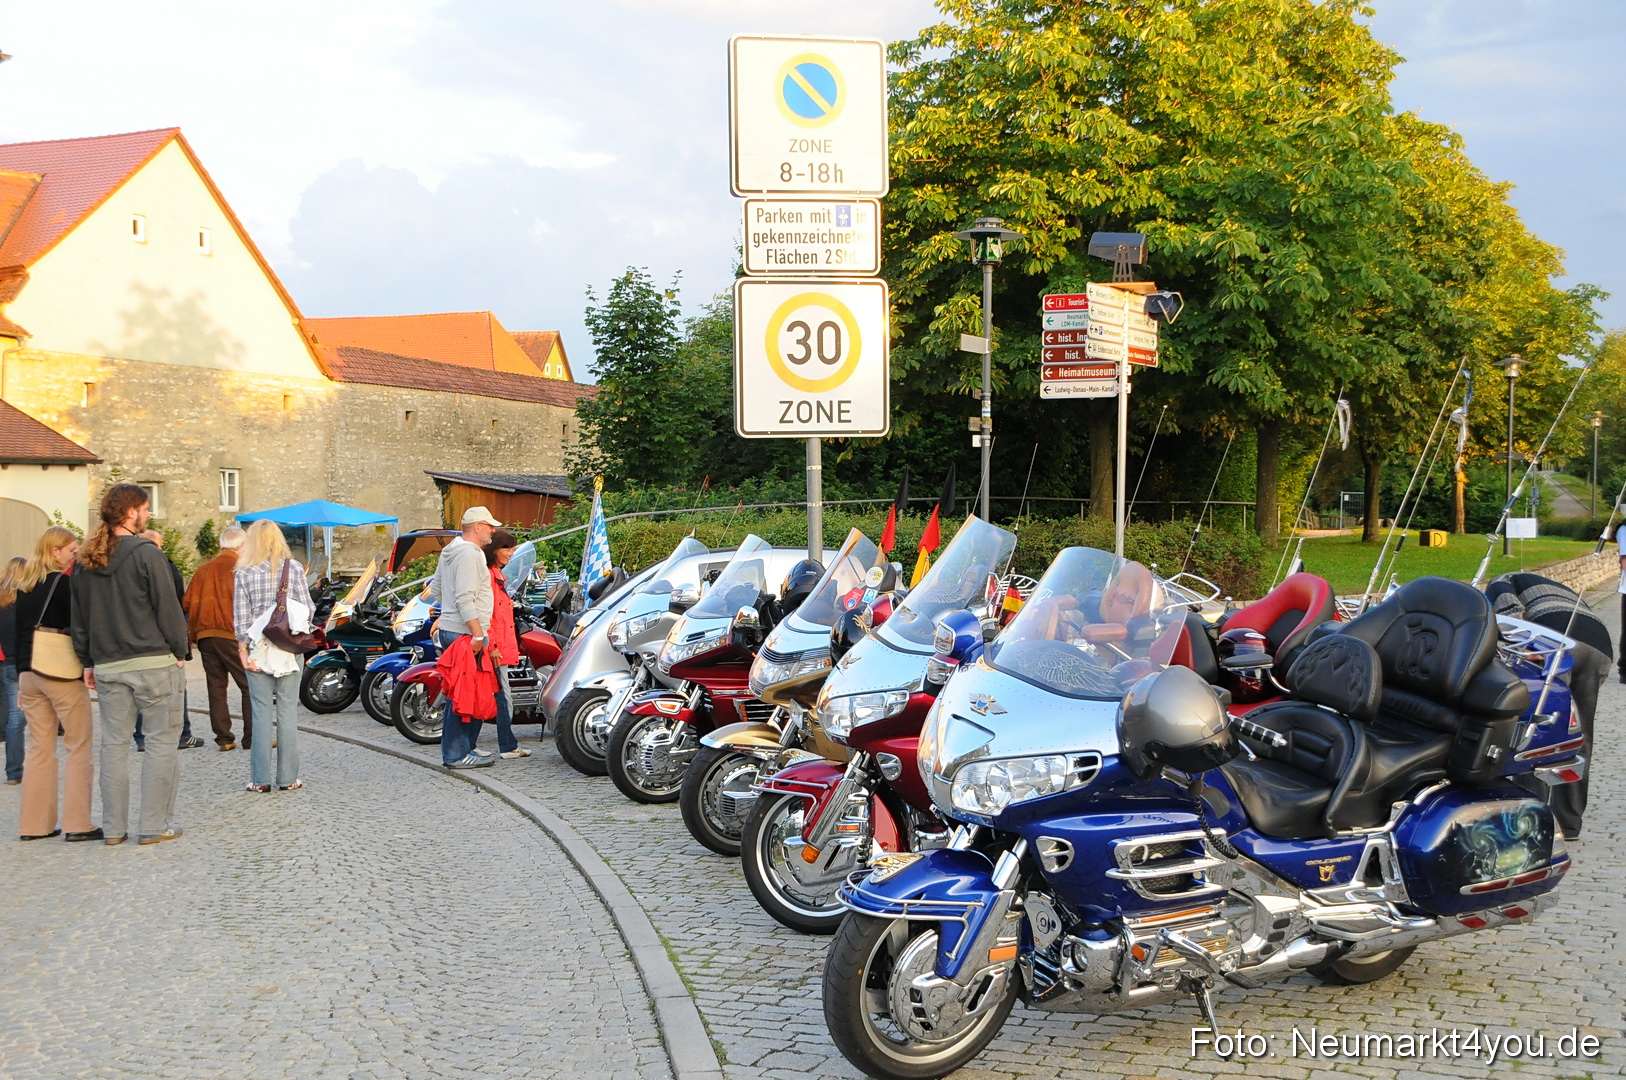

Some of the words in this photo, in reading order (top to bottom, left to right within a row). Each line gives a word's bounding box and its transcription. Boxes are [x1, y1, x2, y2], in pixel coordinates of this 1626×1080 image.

[789, 139, 833, 153] ZONE
[756, 207, 803, 224] Parken
[810, 208, 831, 224] mit
[766, 249, 818, 265] Flächen
[825, 249, 832, 265] 2
[786, 320, 842, 365] 30
[1058, 333, 1074, 343] hist.
[1065, 350, 1081, 360] hist.
[1059, 367, 1115, 378] Heimatmuseum
[1055, 386, 1115, 394] Ludwig-Donau-Main-Kanal
[779, 400, 852, 424] ZONE
[1434, 533, 1442, 546] D
